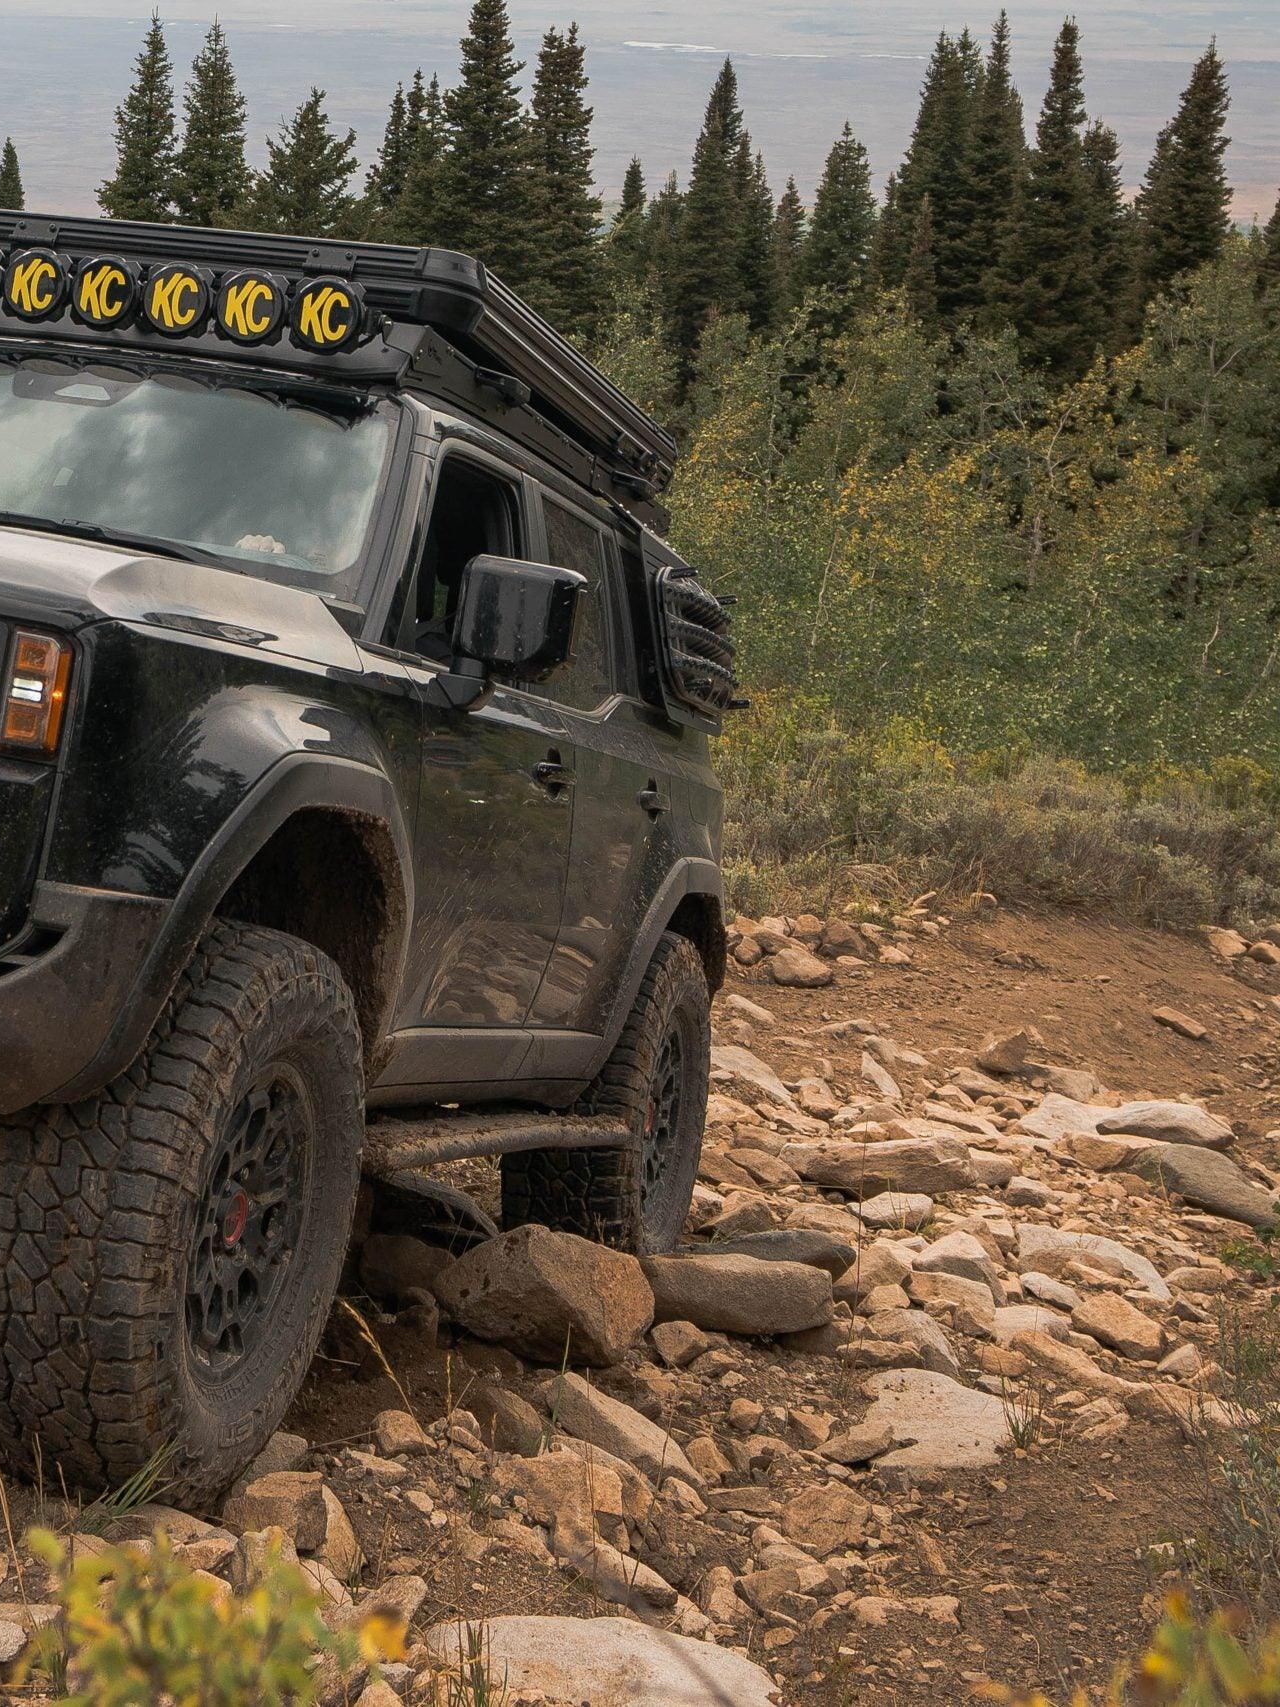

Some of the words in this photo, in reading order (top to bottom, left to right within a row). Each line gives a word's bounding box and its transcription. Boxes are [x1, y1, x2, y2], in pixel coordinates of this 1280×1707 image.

[11, 258, 56, 311] KC
[80, 266, 126, 320] KC
[150, 273, 198, 328] KC
[224, 280, 273, 336] KC
[300, 287, 350, 344] KC
